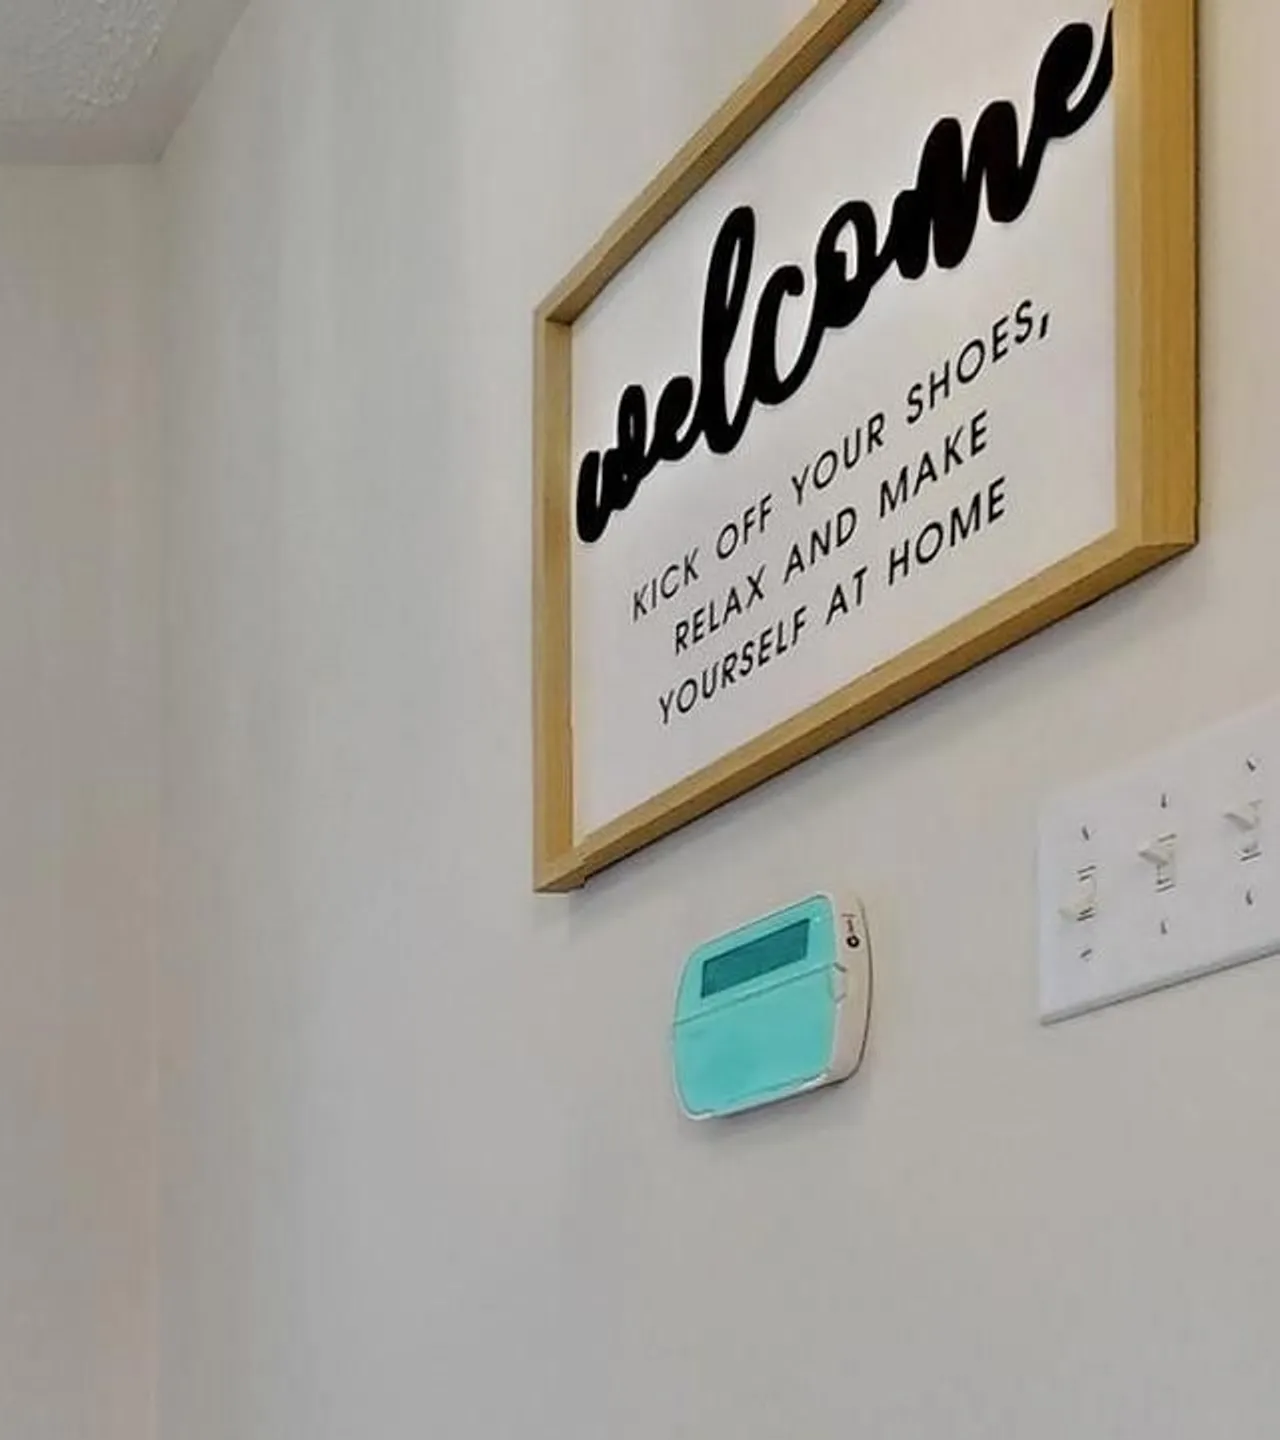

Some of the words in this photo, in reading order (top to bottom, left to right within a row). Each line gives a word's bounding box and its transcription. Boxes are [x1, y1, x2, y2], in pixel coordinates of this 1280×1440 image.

[576, 12, 1114, 543] welcome
[632, 548, 699, 622] KICK
[716, 493, 772, 560] OFF
[790, 412, 885, 505] YOUR
[906, 299, 1050, 425] SHOES,
[658, 606, 807, 725] YOURSELF
[825, 566, 868, 626] AT
[888, 476, 1006, 586] HOME
[675, 565, 766, 656] RELAX
[783, 506, 857, 584] AND
[879, 409, 987, 518] MAKE
